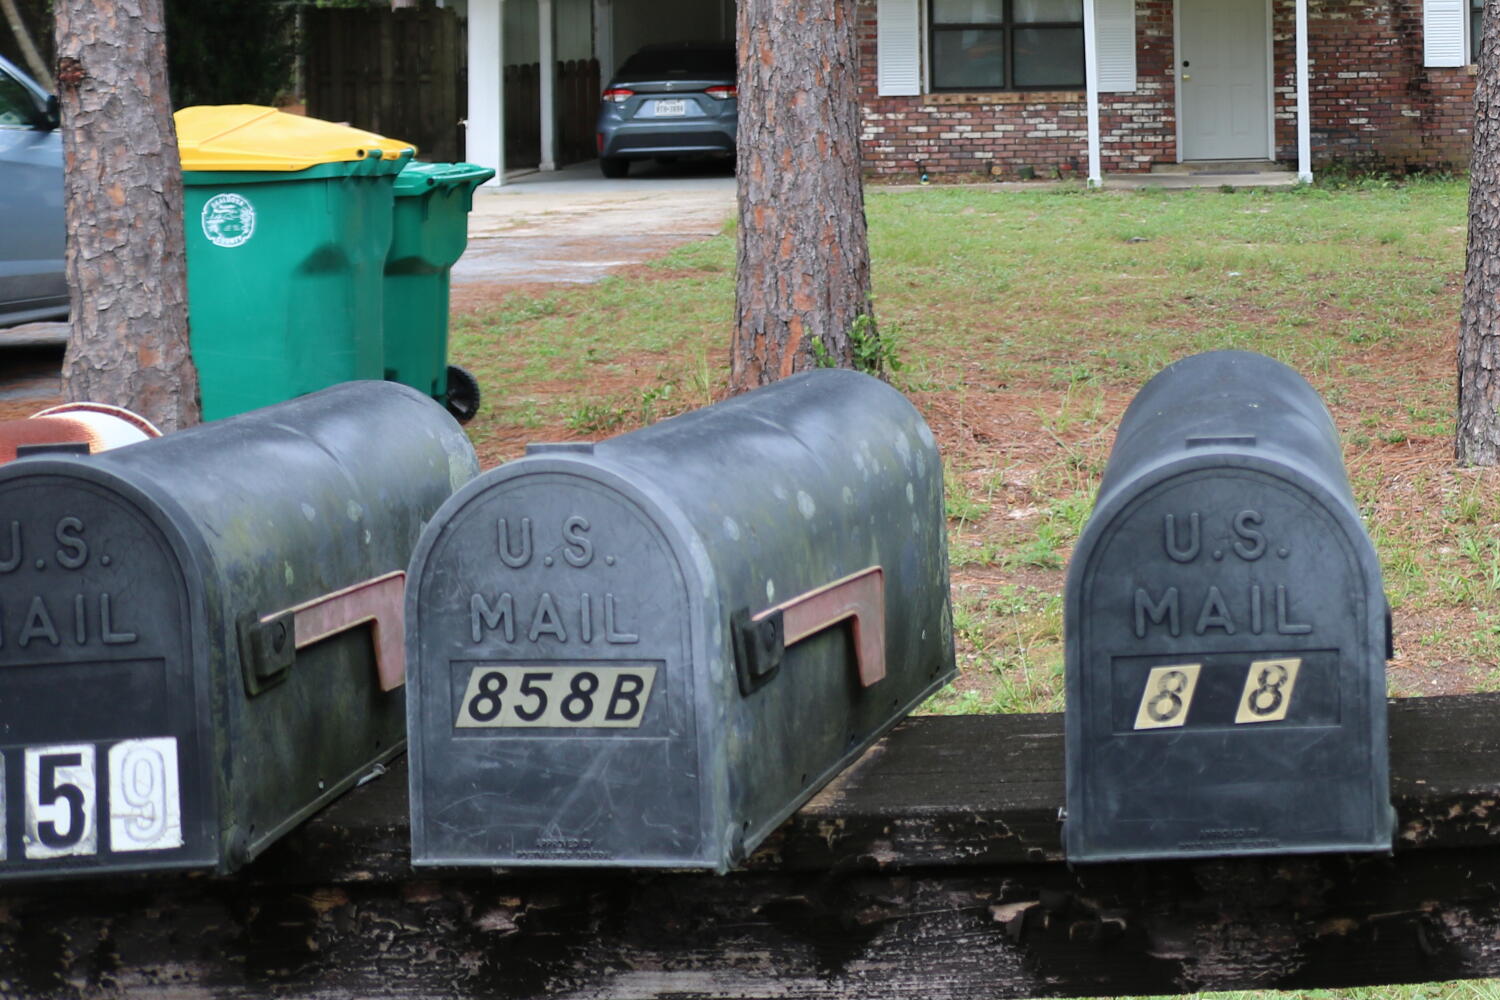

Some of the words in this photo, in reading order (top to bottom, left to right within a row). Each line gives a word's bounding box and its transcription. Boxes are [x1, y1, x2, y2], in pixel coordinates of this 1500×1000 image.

[498, 515, 615, 568] U.S.
[1165, 510, 1288, 562] U.S.
[0, 593, 137, 646] AIL
[470, 593, 639, 643] MAIL
[1134, 585, 1312, 637] MAIL
[468, 672, 644, 722] 858B
